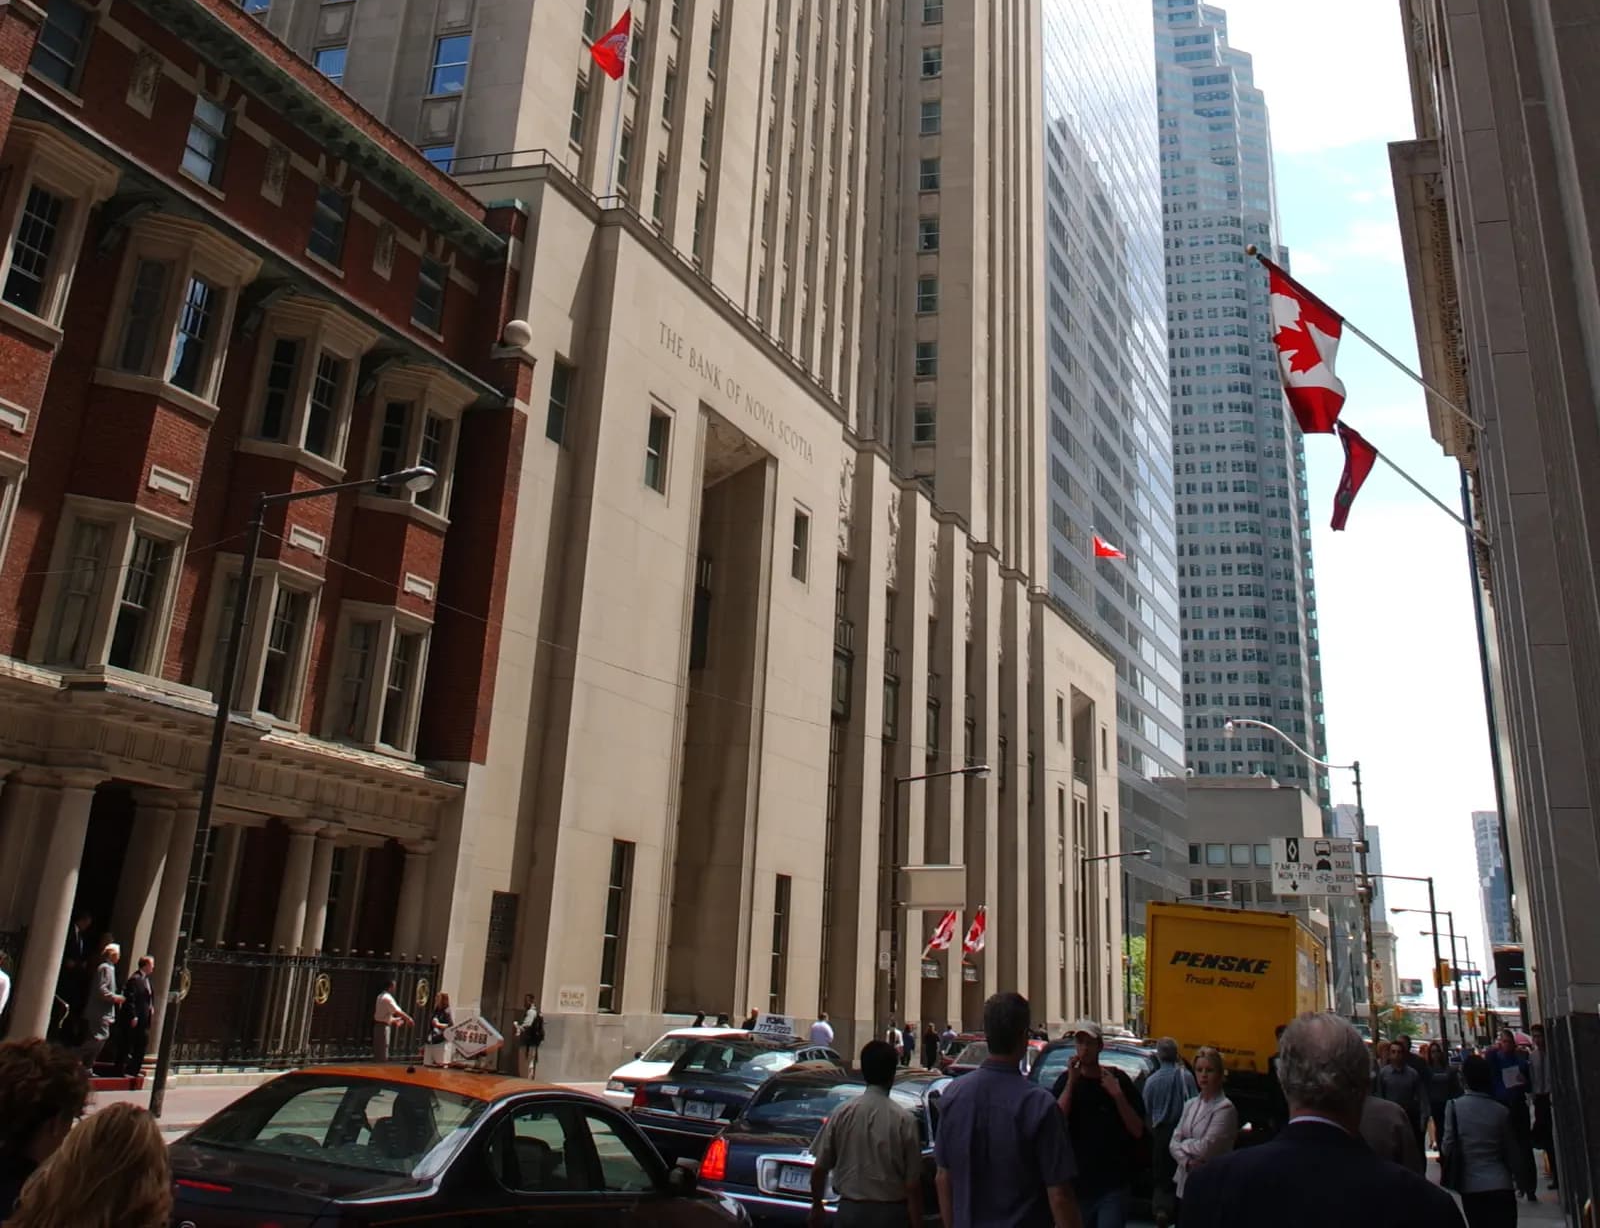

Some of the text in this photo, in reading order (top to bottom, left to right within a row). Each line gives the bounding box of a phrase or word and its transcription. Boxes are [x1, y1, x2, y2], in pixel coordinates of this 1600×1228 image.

[659, 321, 814, 464] THE BANK OF NOVA SCOTIA
[1281, 862, 1291, 870] AM
[1303, 863, 1313, 871] PM
[1169, 950, 1272, 975] PENSKE
[1185, 973, 1256, 990] Truck Rental
